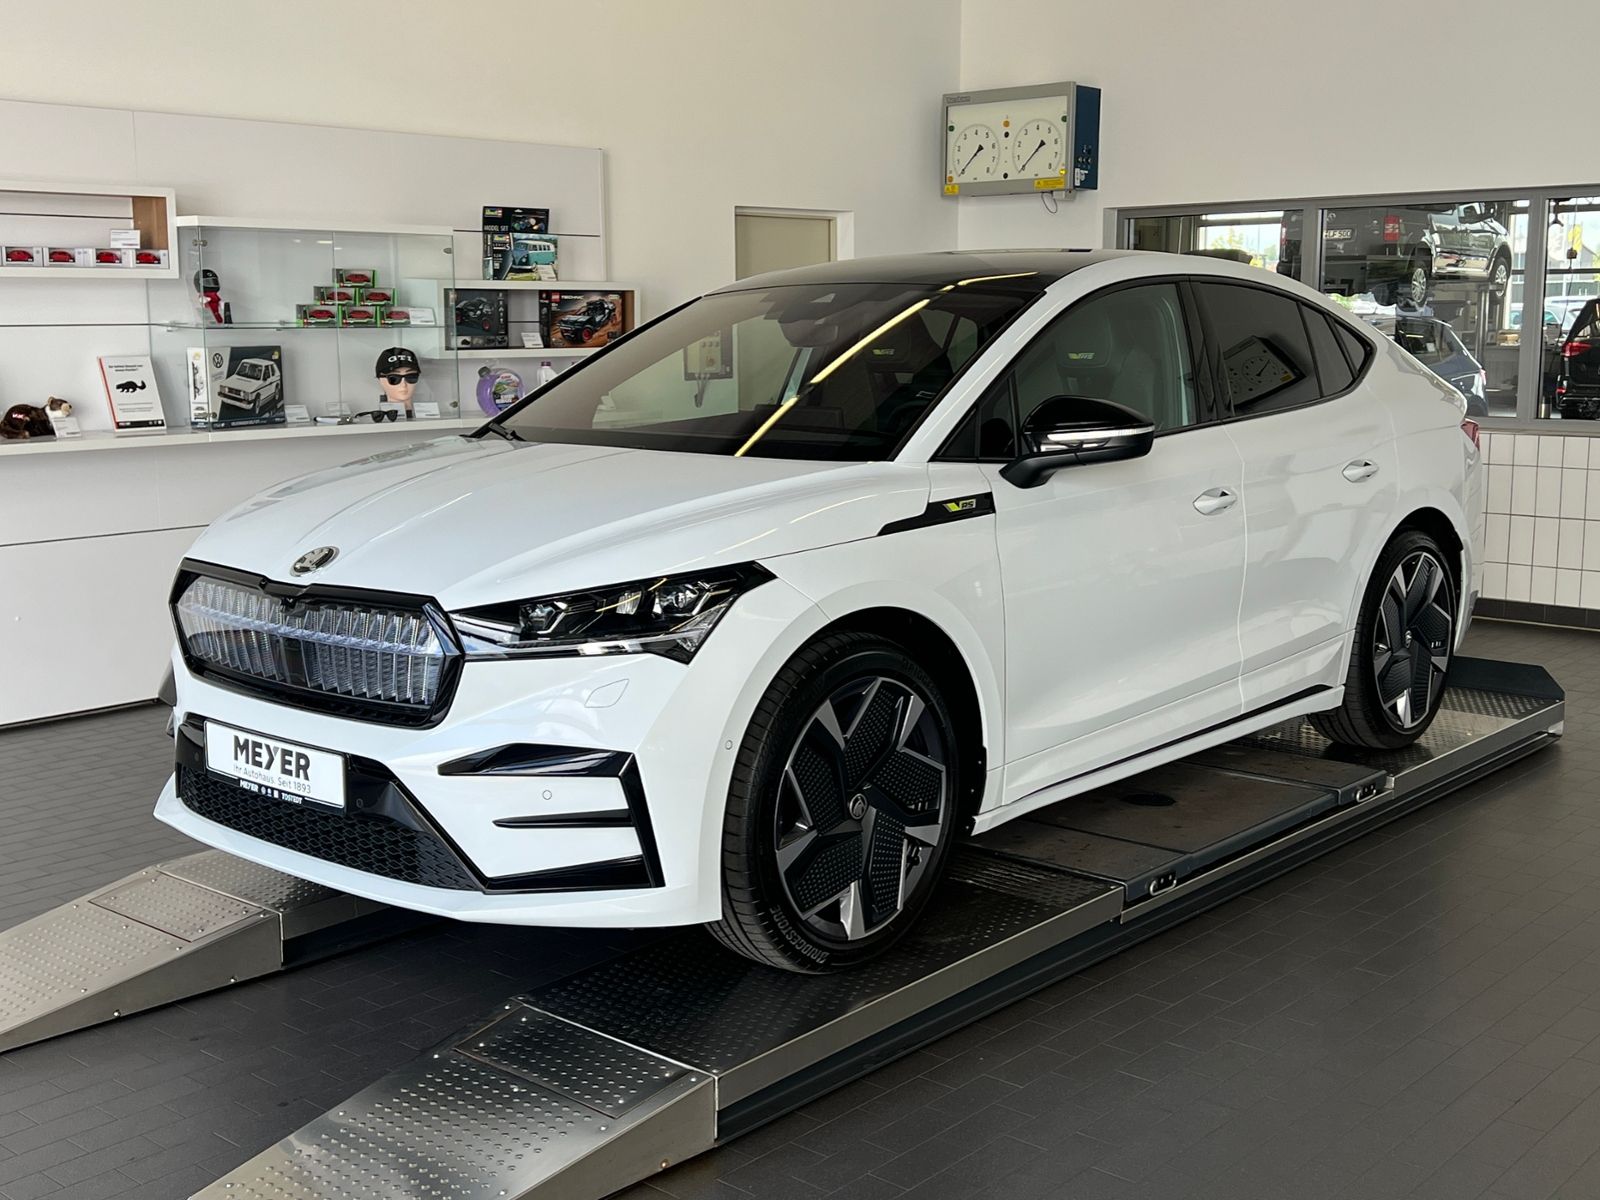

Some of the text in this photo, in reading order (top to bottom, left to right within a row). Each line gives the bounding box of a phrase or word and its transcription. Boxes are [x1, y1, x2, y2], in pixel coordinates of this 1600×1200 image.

[233, 764, 242, 773] Ihr
[278, 777, 291, 789] Seit
[294, 782, 311, 794] 1893
[234, 735, 310, 781] MEYER
[769, 904, 830, 964] BRIDGESTONE
